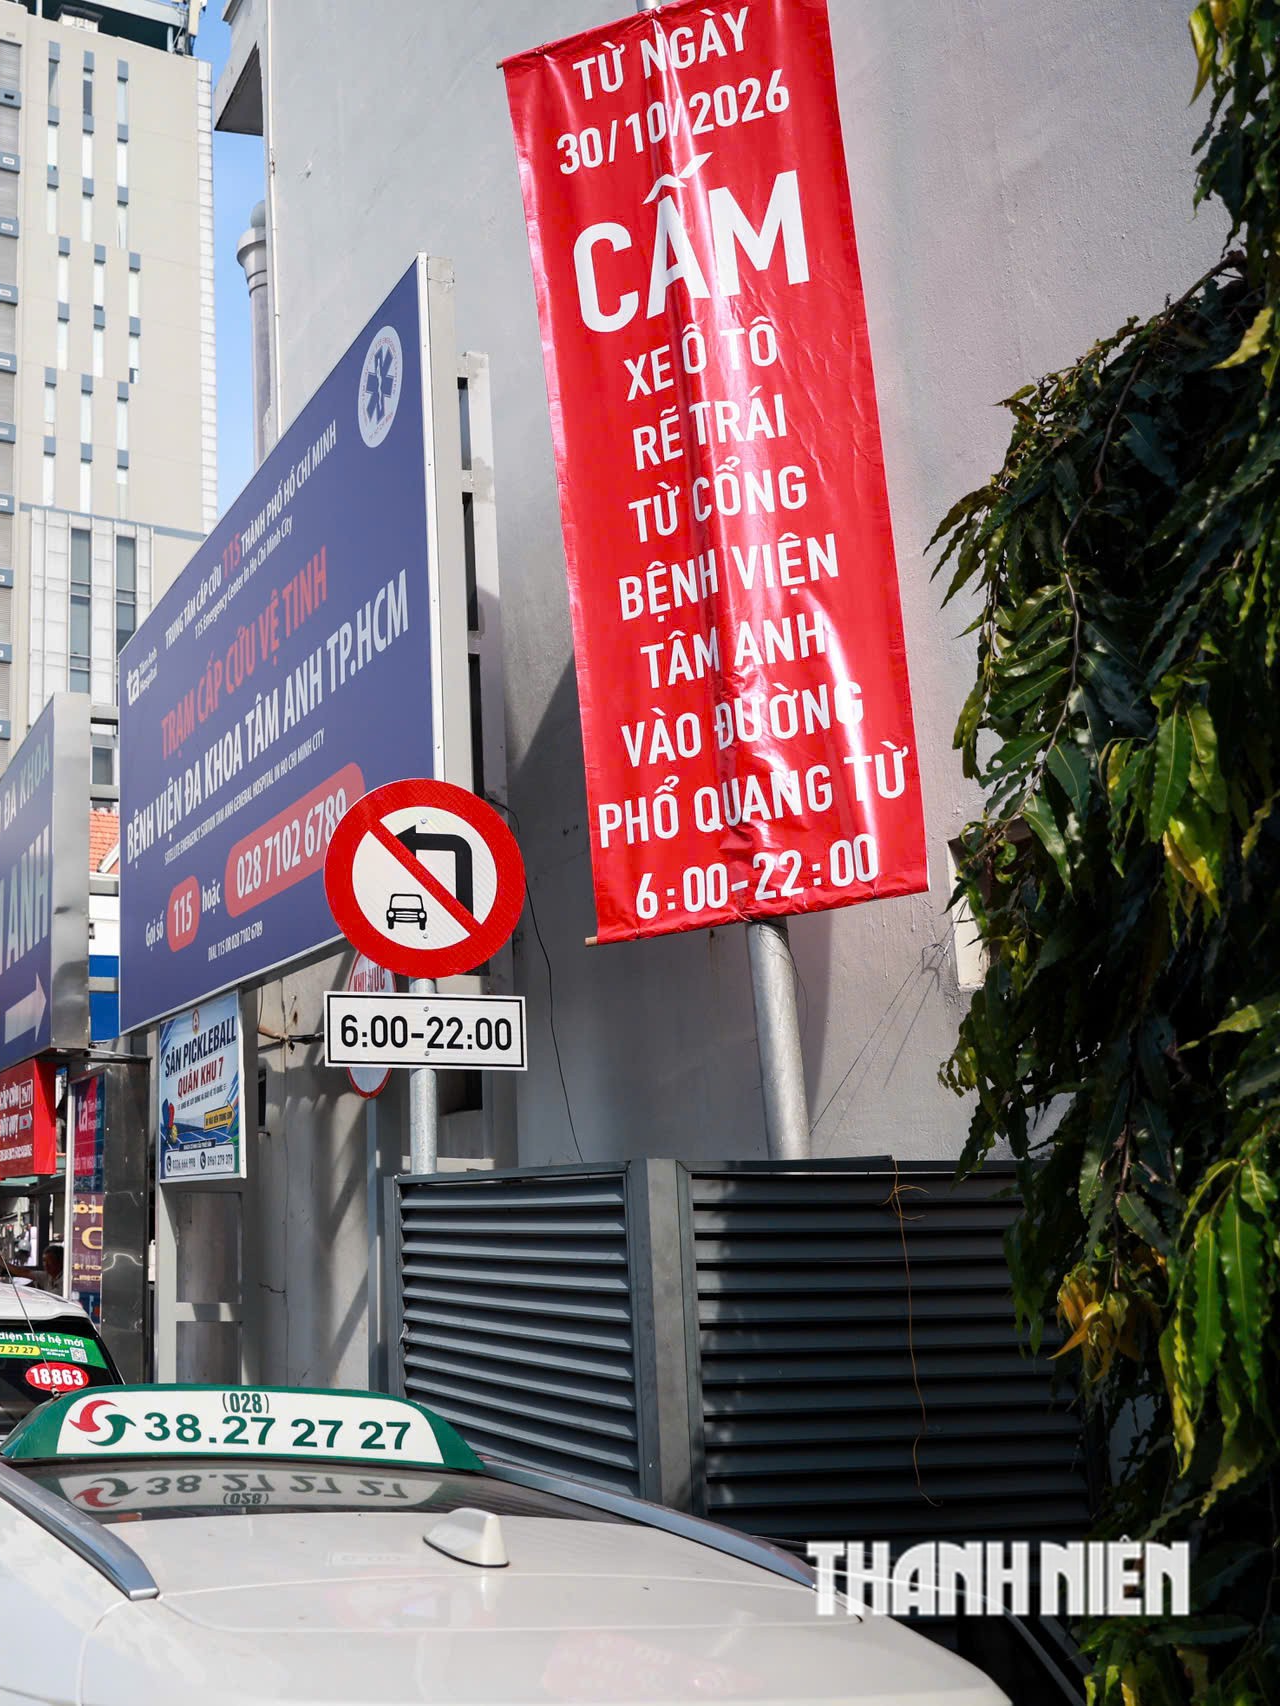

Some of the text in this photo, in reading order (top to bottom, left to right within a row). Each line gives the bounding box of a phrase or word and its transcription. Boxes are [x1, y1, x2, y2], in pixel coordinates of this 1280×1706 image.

[573, 7, 749, 100] TỪ NGÀY
[557, 69, 790, 174] 30/10/2026
[573, 152, 810, 333] CẤM
[624, 317, 777, 400] XE Ô TÔ
[633, 387, 787, 470] RẼ TRÁI
[165, 612, 183, 650] TRUNG
[184, 597, 196, 628] TÂM
[197, 578, 208, 611] CẤP
[223, 532, 240, 578] 115
[241, 509, 265, 557] THÀNH
[267, 479, 283, 527] PHỐ
[284, 465, 296, 506] HỒ
[297, 446, 310, 488] CHÍ
[313, 420, 337, 471] MINH
[628, 457, 807, 543] TỪ CỔNG
[203, 593, 228, 629] Emergency
[228, 574, 243, 600] Center
[267, 527, 281, 556] Minh
[281, 515, 293, 538] City
[619, 532, 840, 622] BỆNH VIỆN
[161, 545, 327, 760] TRẠM CẤP CỨU VỆ TINH
[640, 610, 826, 688] TÂM ANH
[127, 568, 409, 869] BỆNH VIỆN ĐA KHOA TÂM ANH TP.HCM
[621, 681, 864, 767] VÀO ĐƯỜNG
[4, 781, 16, 831] ĐA
[20, 736, 50, 809] KHOA
[598, 741, 909, 848] PHỔ QUANG TỪ
[6, 824, 50, 970] ANH
[174, 890, 192, 937] 115
[202, 878, 220, 914] hoặc
[237, 845, 261, 898] 028
[265, 819, 300, 883] 7102
[166, 1016, 236, 1077] SÂN PICKLEBALL
[341, 1014, 512, 1050] 6:00-22:00
[178, 1069, 198, 1098] QUÂN
[201, 1059, 216, 1086] KHU
[219, 1056, 224, 1077] 7
[24, 1332, 46, 1343] Thế
[47, 1334, 62, 1346] hệ
[63, 1337, 85, 1348] mới
[31, 1368, 84, 1386] 18863
[144, 1413, 411, 1450] 38.27 27 27
[222, 1393, 269, 1414] (028)
